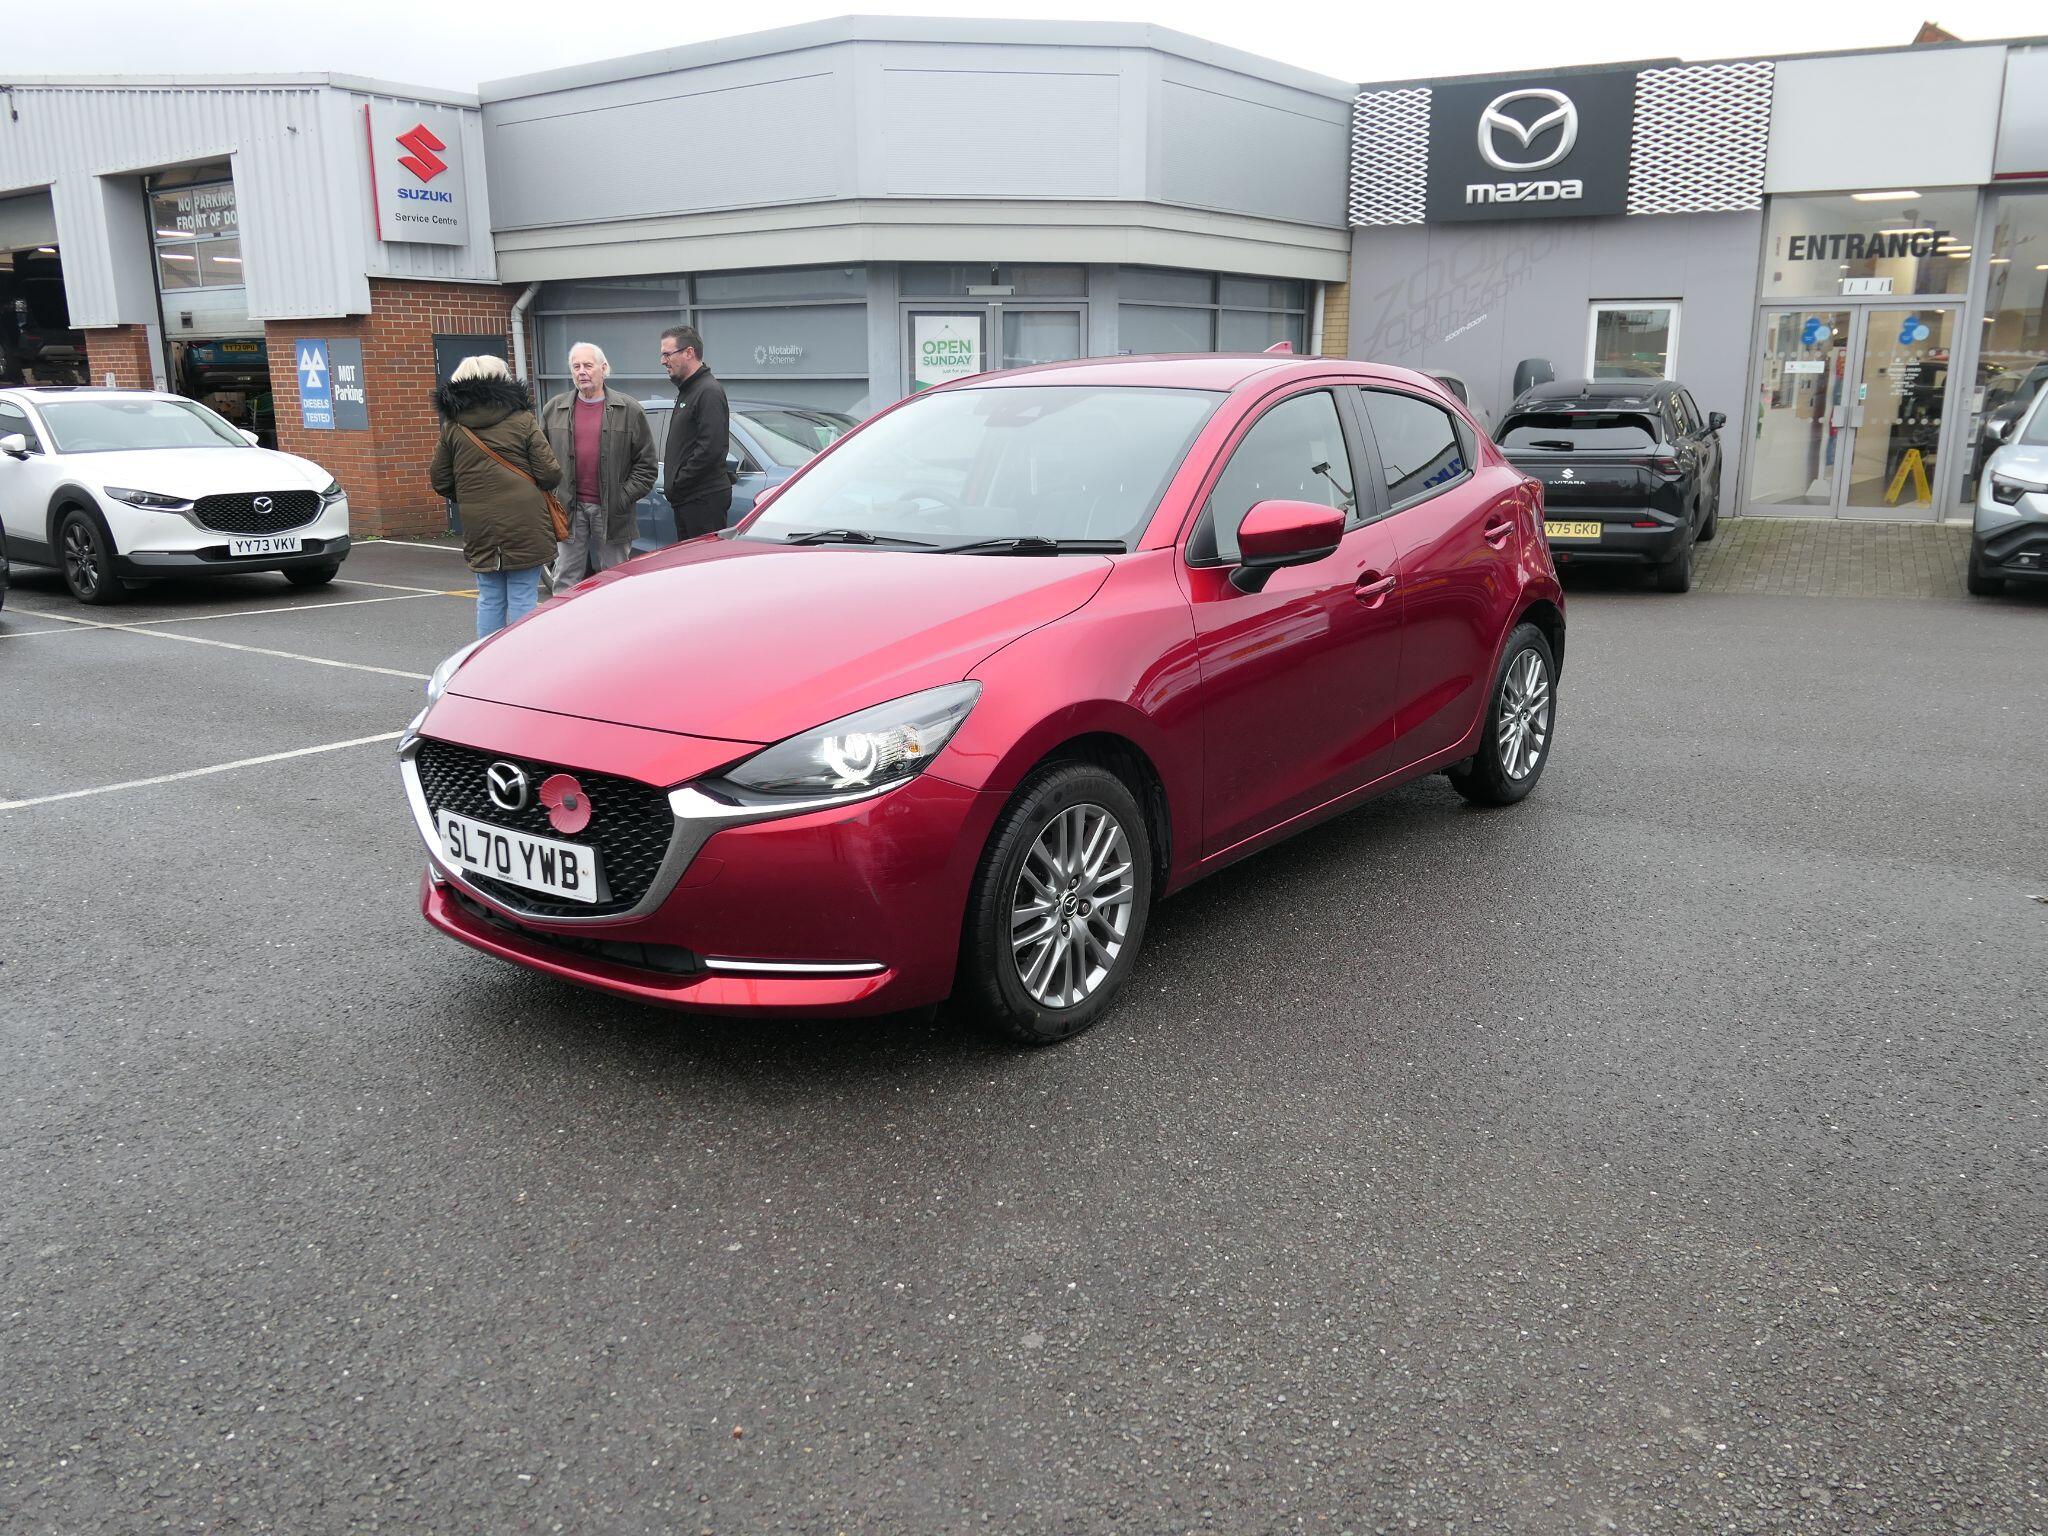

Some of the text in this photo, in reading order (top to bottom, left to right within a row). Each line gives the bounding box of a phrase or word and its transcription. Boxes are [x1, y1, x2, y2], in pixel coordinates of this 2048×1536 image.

[397, 188, 453, 203] SUZUKI
[1466, 179, 1583, 204] mazda
[177, 192, 235, 212] NO PARKING
[176, 213, 207, 230] FRONT
[210, 212, 221, 227] OF
[395, 212, 458, 226] Service Centre
[1788, 230, 1950, 261] ENTRANCE
[1445, 313, 1487, 342] zoom-zoom
[769, 345, 802, 357] Motability
[922, 339, 972, 354] OPEN
[769, 355, 796, 364] Scheme
[922, 355, 972, 366] SUNDAY
[338, 365, 355, 381] MOT
[334, 385, 364, 404] Parking
[303, 398, 329, 409] DIESELS
[306, 412, 331, 423] TESTED
[1544, 522, 1599, 535] X75 GKO
[235, 538, 296, 553] YY73 VKV
[448, 820, 579, 890] SL70 YWB
